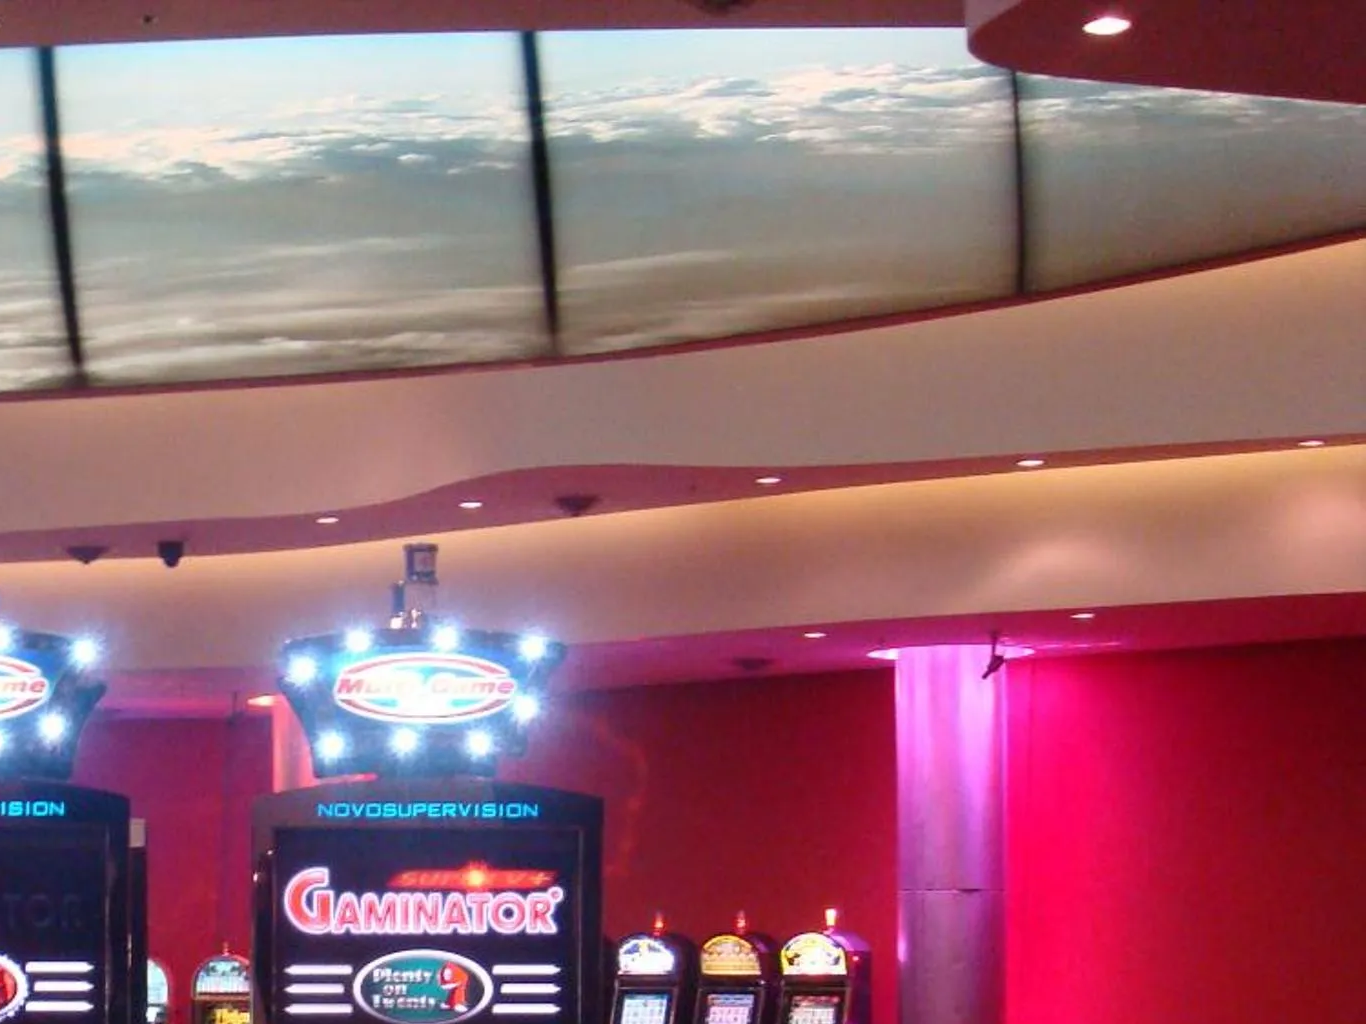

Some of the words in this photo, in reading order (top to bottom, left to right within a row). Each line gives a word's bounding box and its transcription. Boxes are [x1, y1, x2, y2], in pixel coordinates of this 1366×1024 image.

[317, 802, 539, 818] NOVOSUPERVISION
[285, 867, 562, 934] GAMINATOR
[372, 967, 433, 984] Plenty
[382, 984, 408, 996] on
[371, 994, 437, 1009] Twenty
